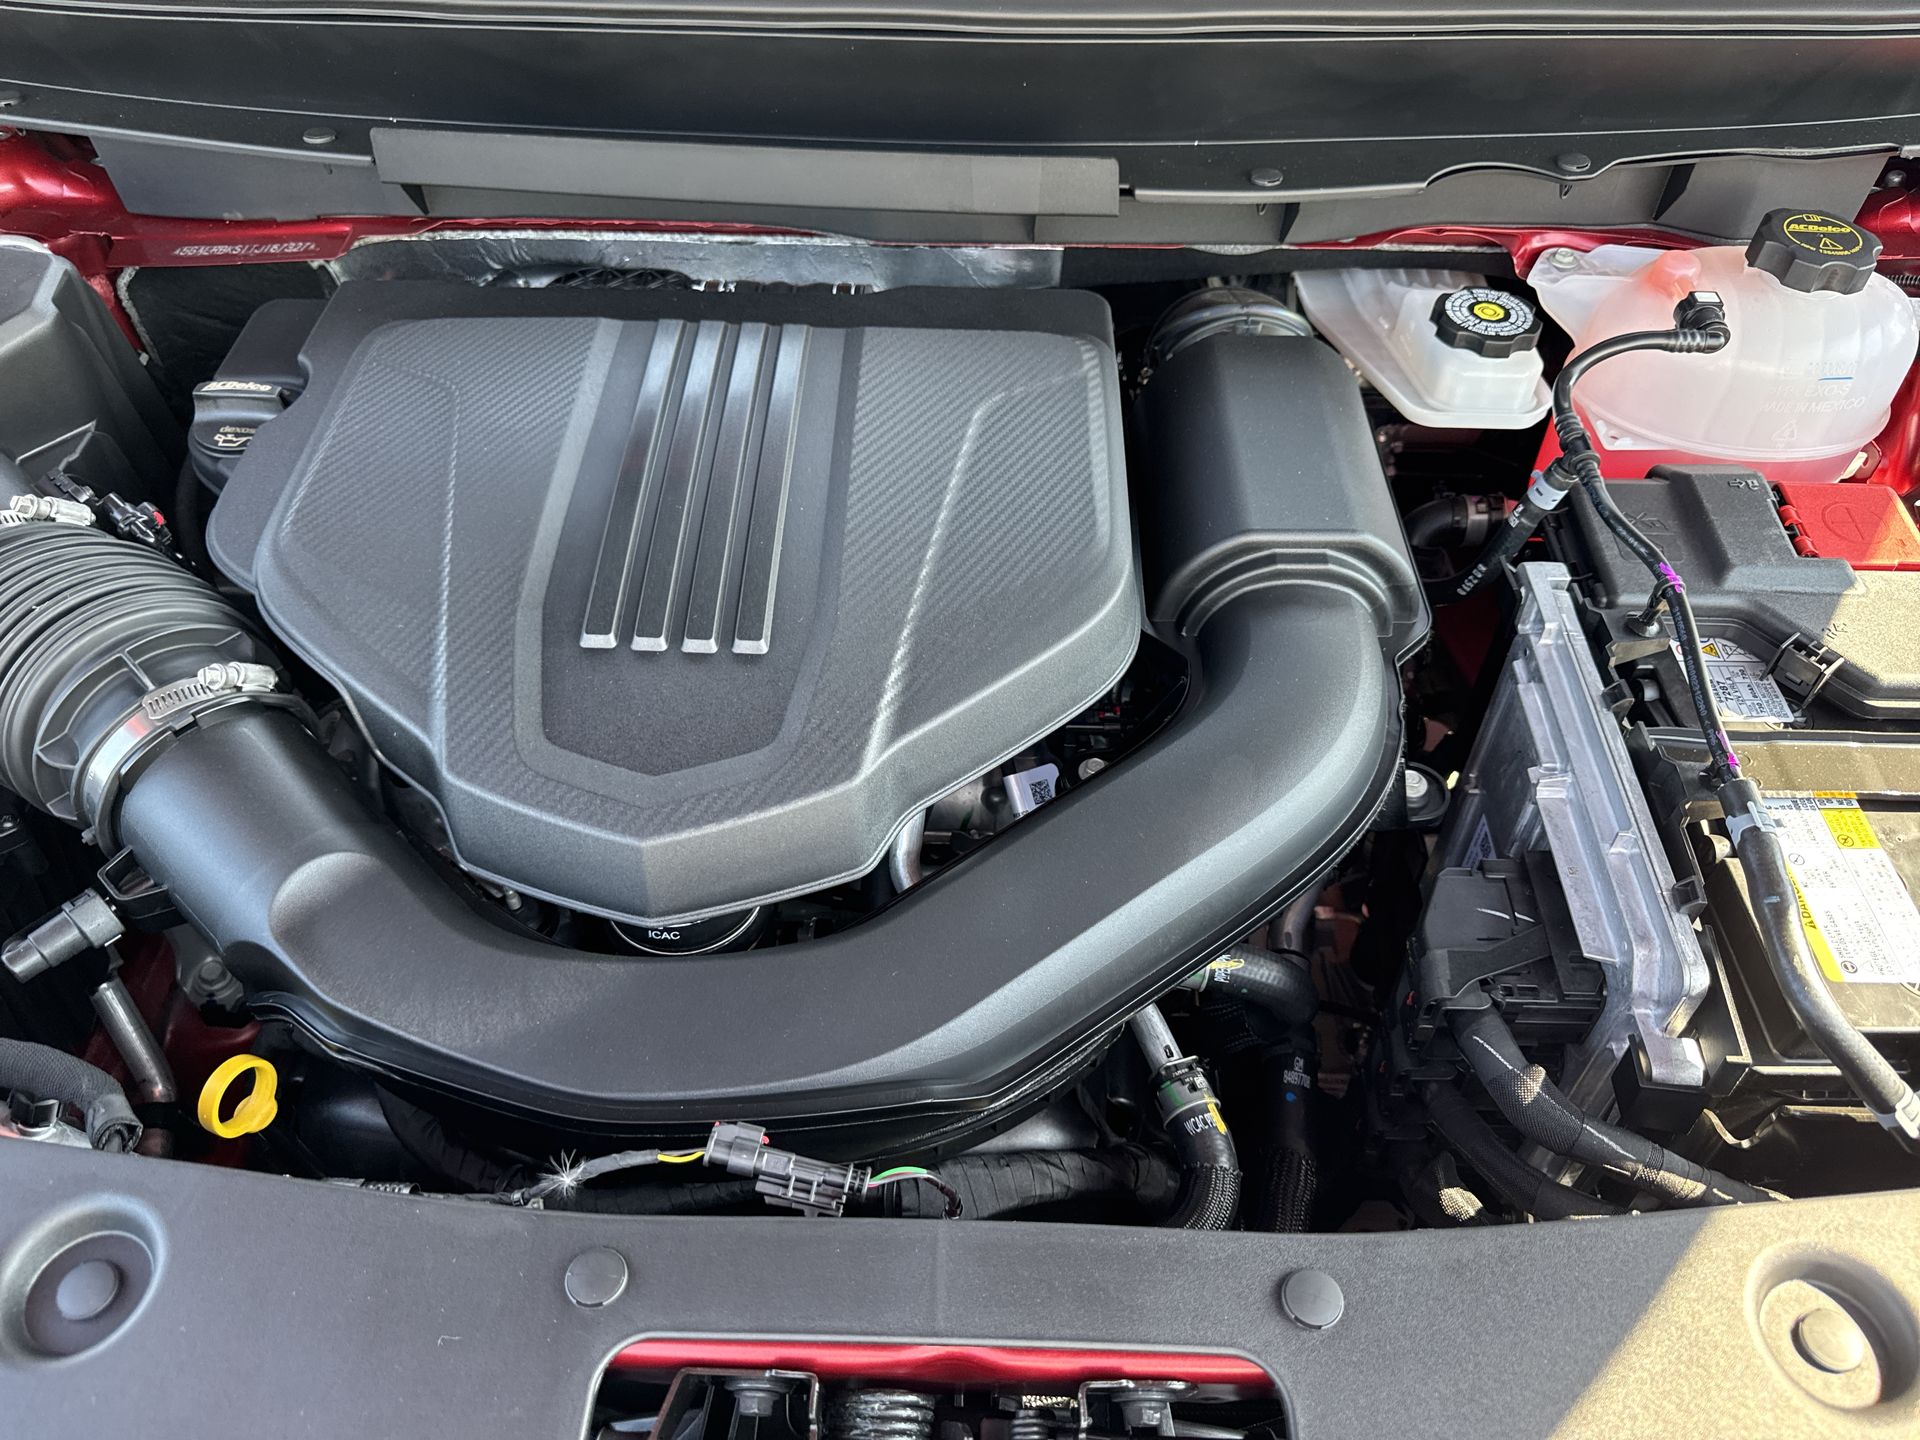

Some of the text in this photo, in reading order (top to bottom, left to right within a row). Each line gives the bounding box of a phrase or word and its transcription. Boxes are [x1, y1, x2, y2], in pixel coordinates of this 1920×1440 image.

[1788, 223, 1851, 233] ACDelco
[201, 381, 272, 391] ACDelco
[1715, 679, 1734, 702] 7287
[648, 930, 680, 940] ICAC
